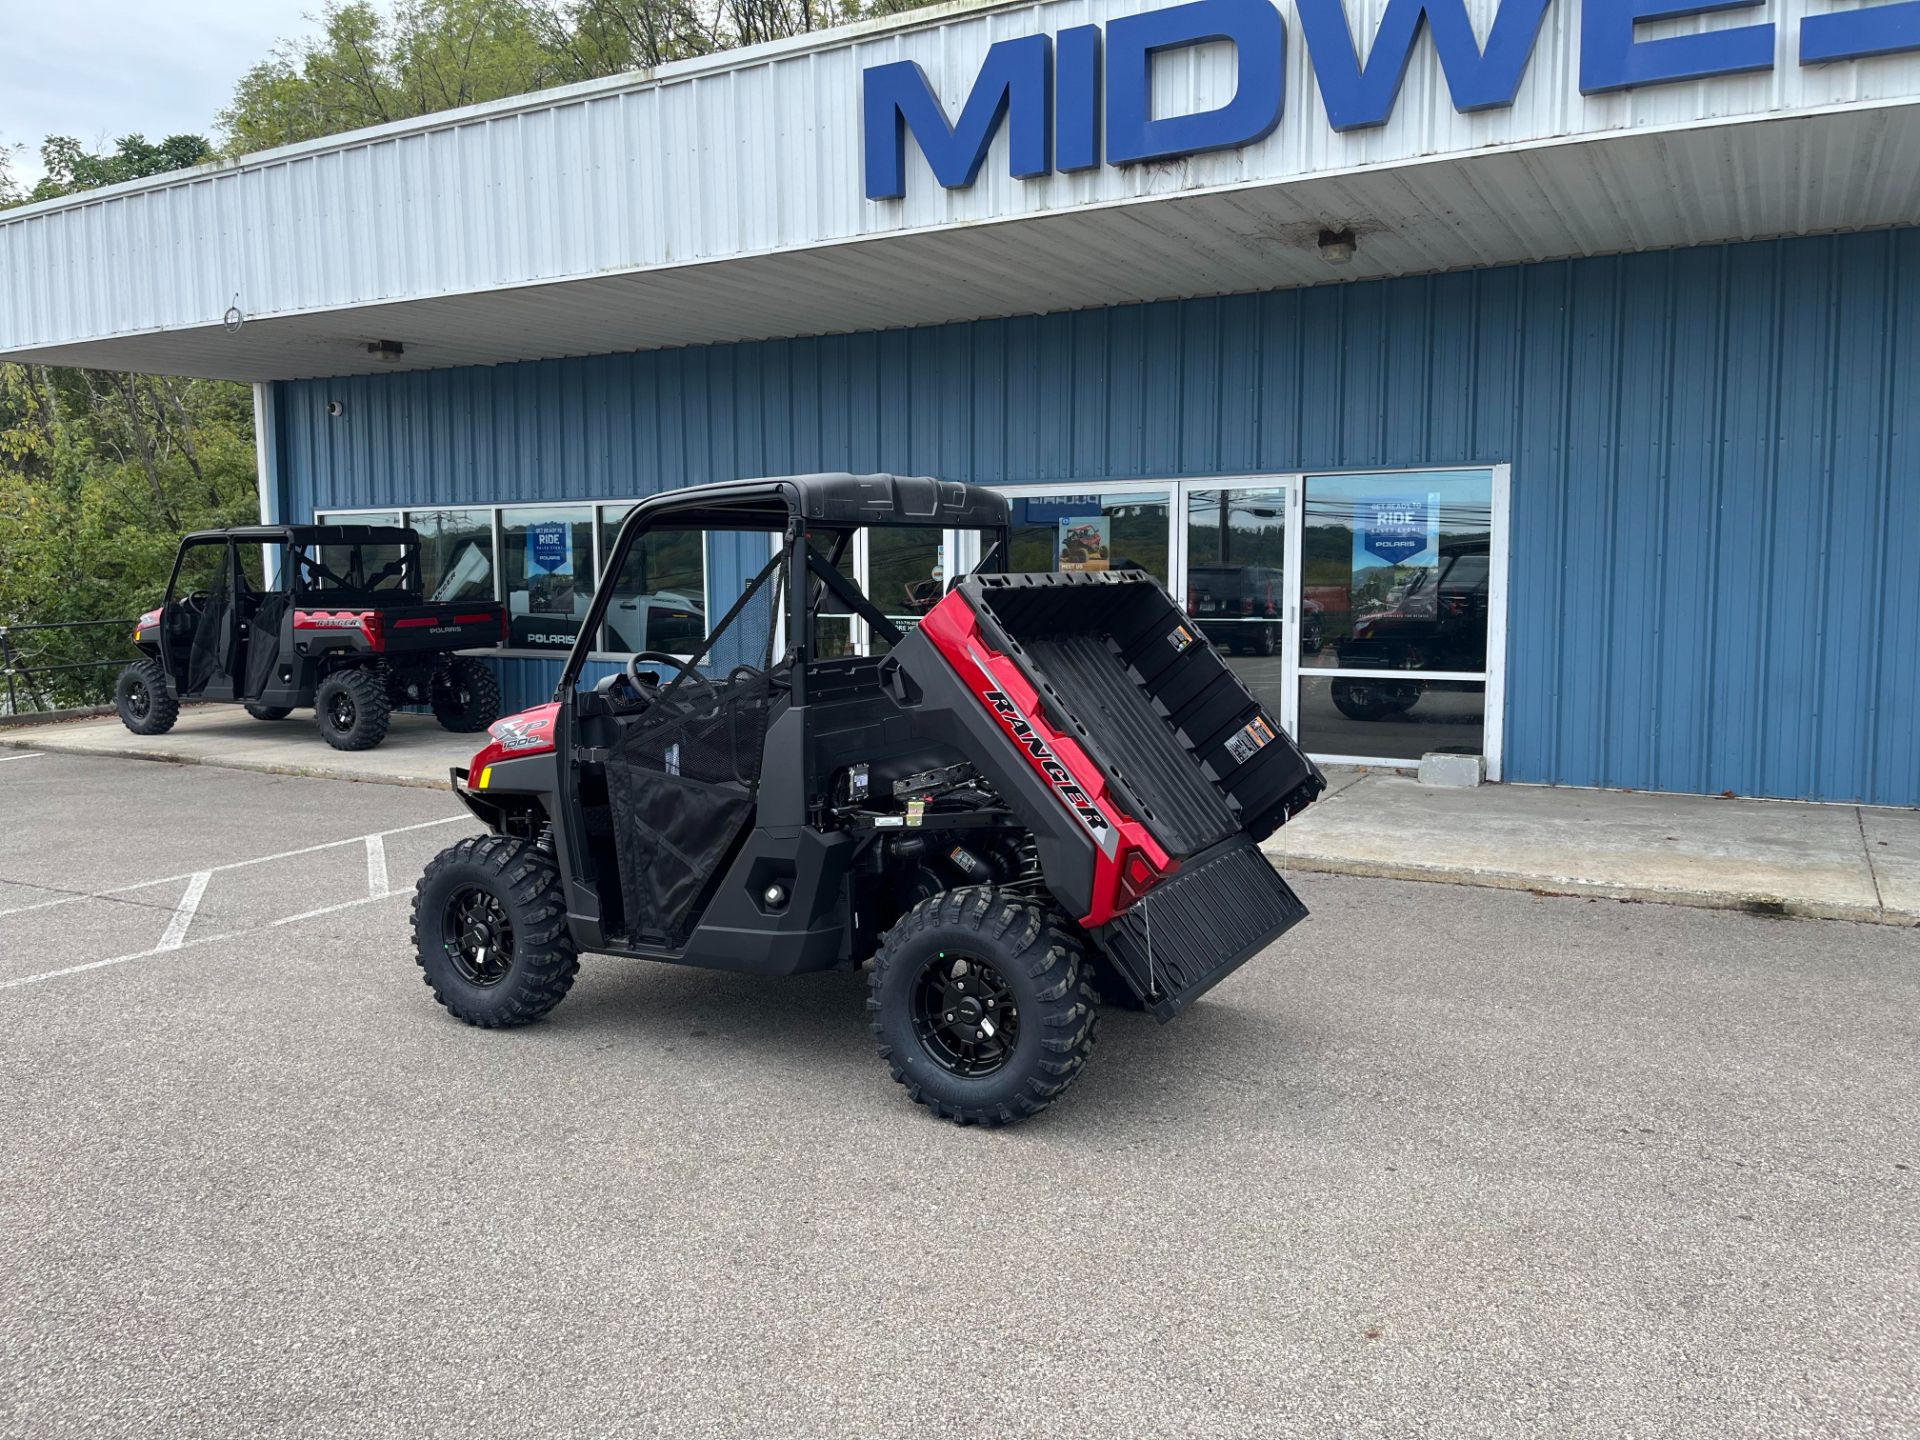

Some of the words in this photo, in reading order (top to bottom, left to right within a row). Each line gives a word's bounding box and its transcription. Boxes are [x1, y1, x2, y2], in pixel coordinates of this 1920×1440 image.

[863, 0, 1920, 202] MIDWE
[1377, 511, 1415, 526] RIDE
[539, 534, 560, 545] RIDE
[316, 619, 358, 627] RANGER
[430, 626, 462, 635] POLARIS
[527, 633, 576, 645] POLARIS
[495, 719, 549, 741] XP
[503, 735, 541, 749] 1000
[983, 690, 1109, 830] RANGER
